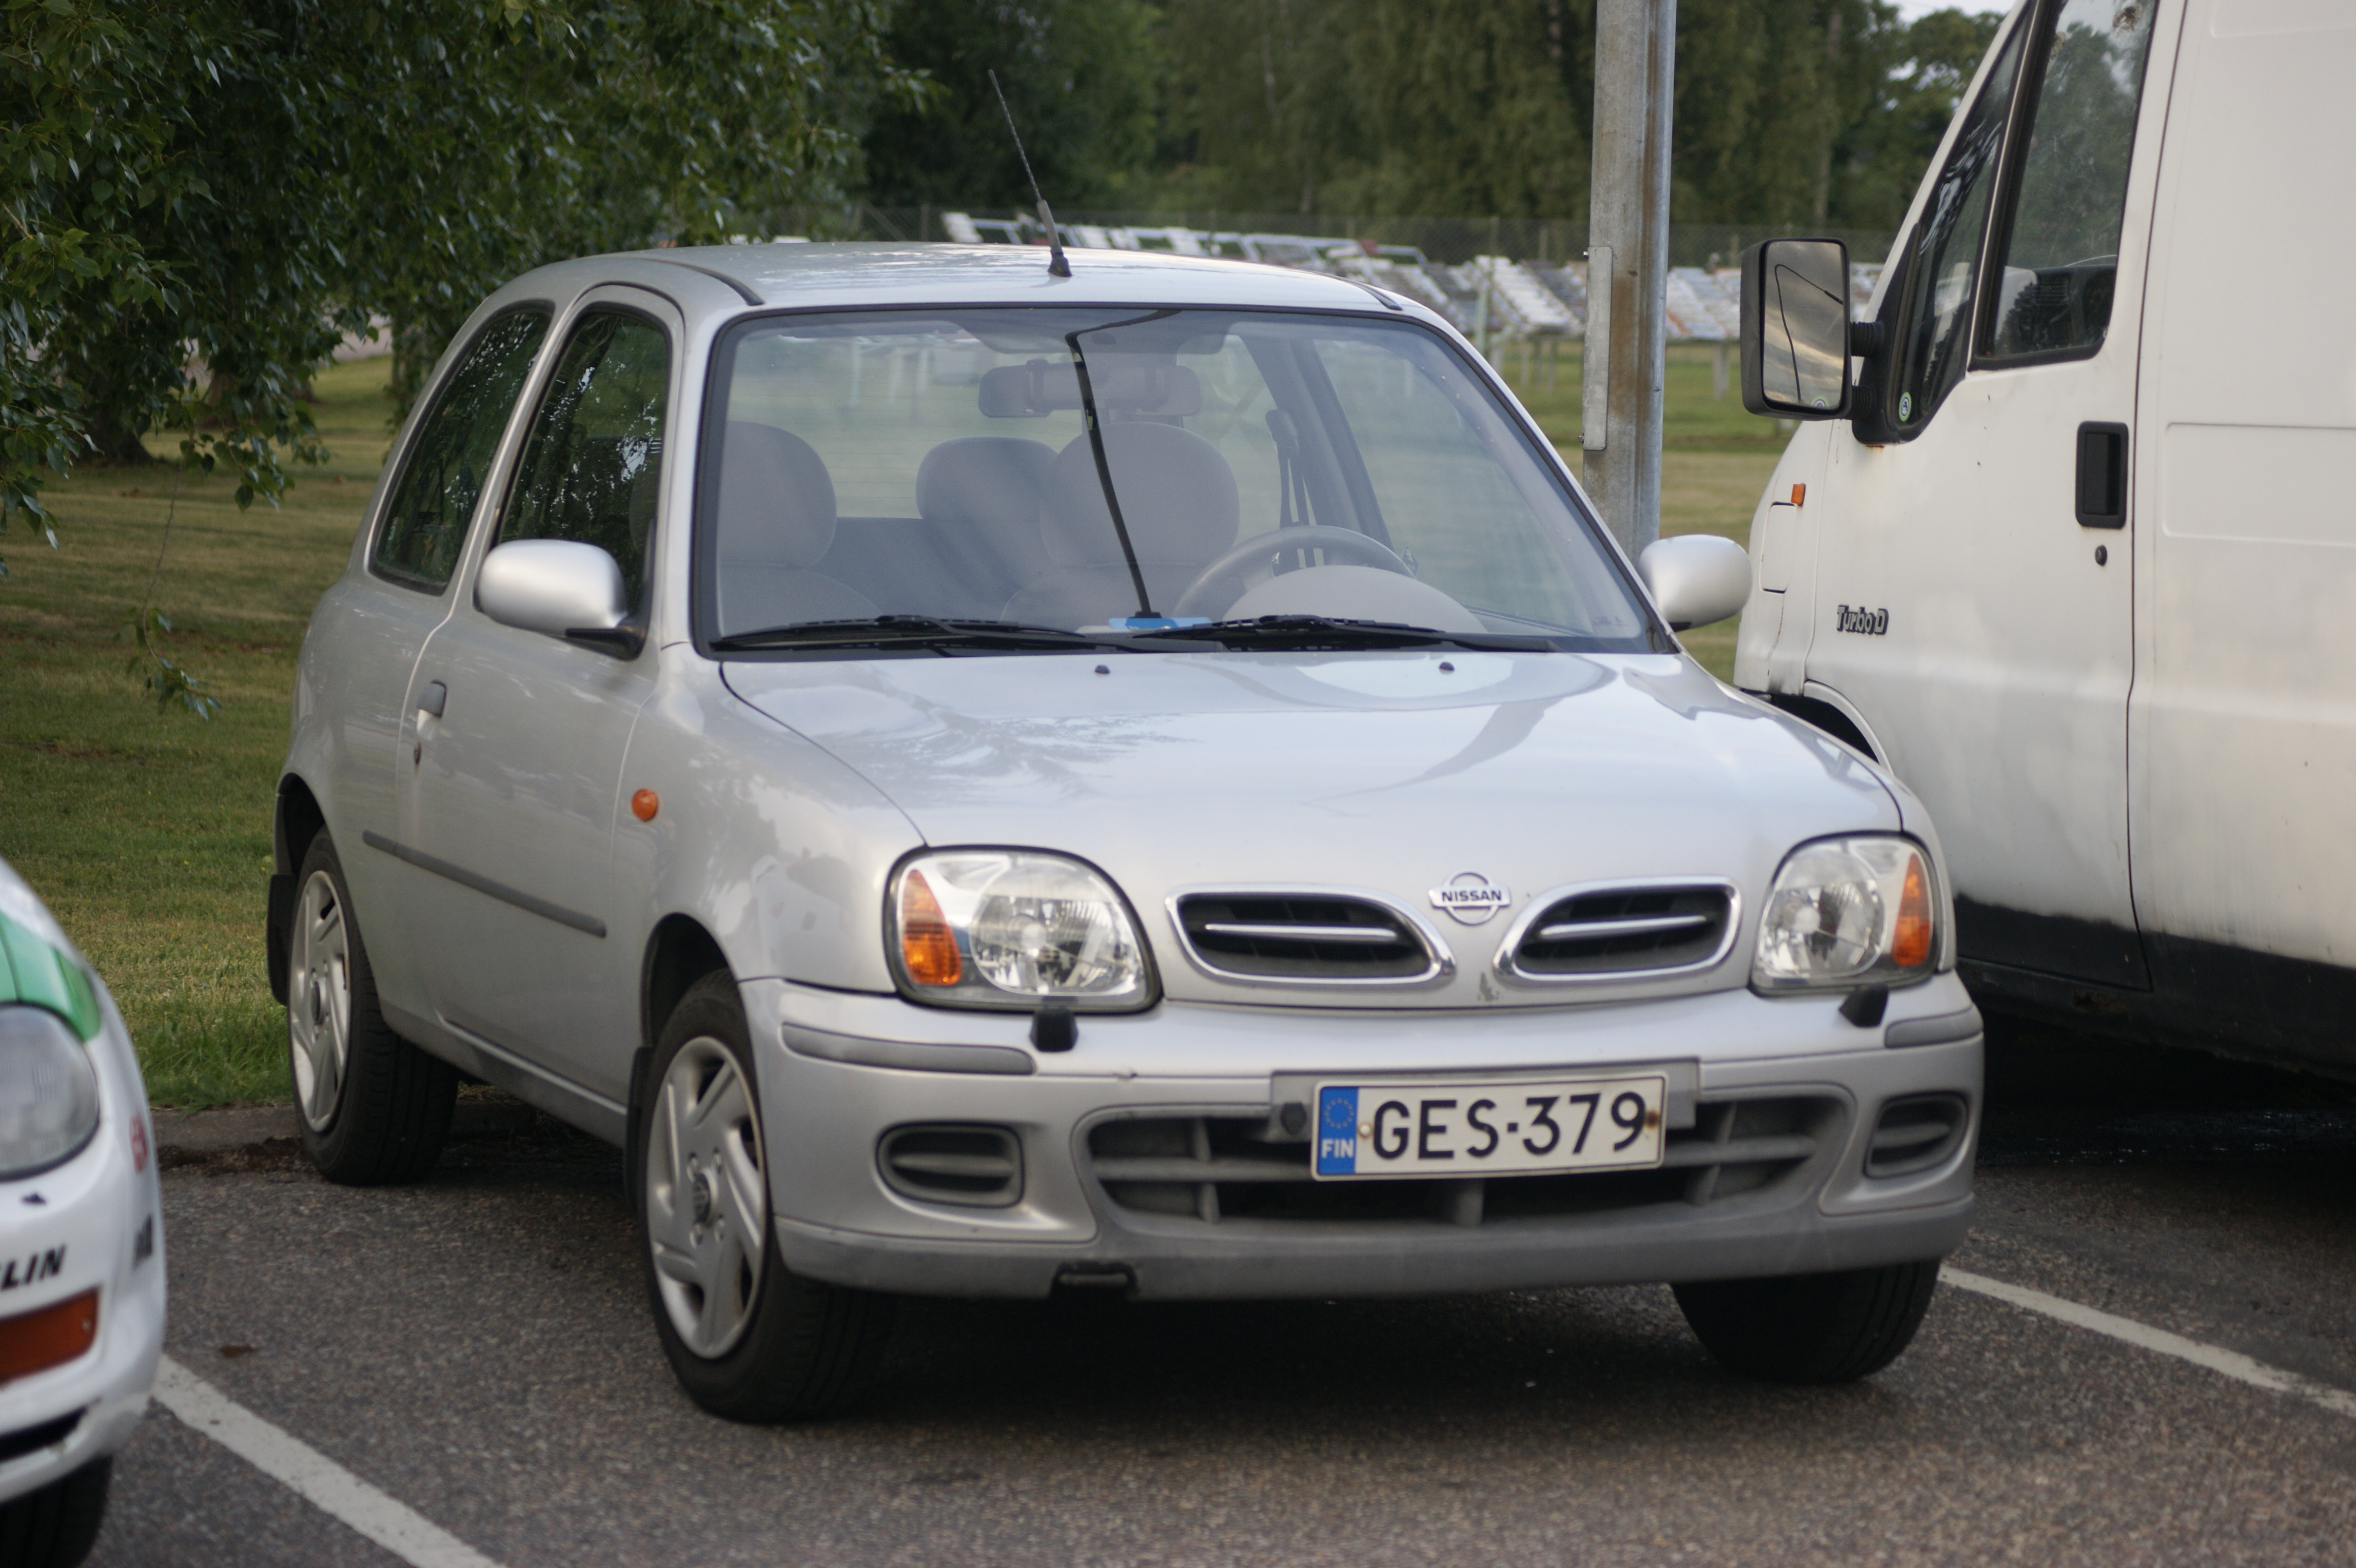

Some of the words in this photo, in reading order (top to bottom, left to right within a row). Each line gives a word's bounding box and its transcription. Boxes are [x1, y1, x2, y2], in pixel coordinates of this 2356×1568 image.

[1442, 890, 1501, 902] NISSAN
[1372, 1091, 1646, 1160] GES-379
[1322, 1138, 1354, 1158] FIN
